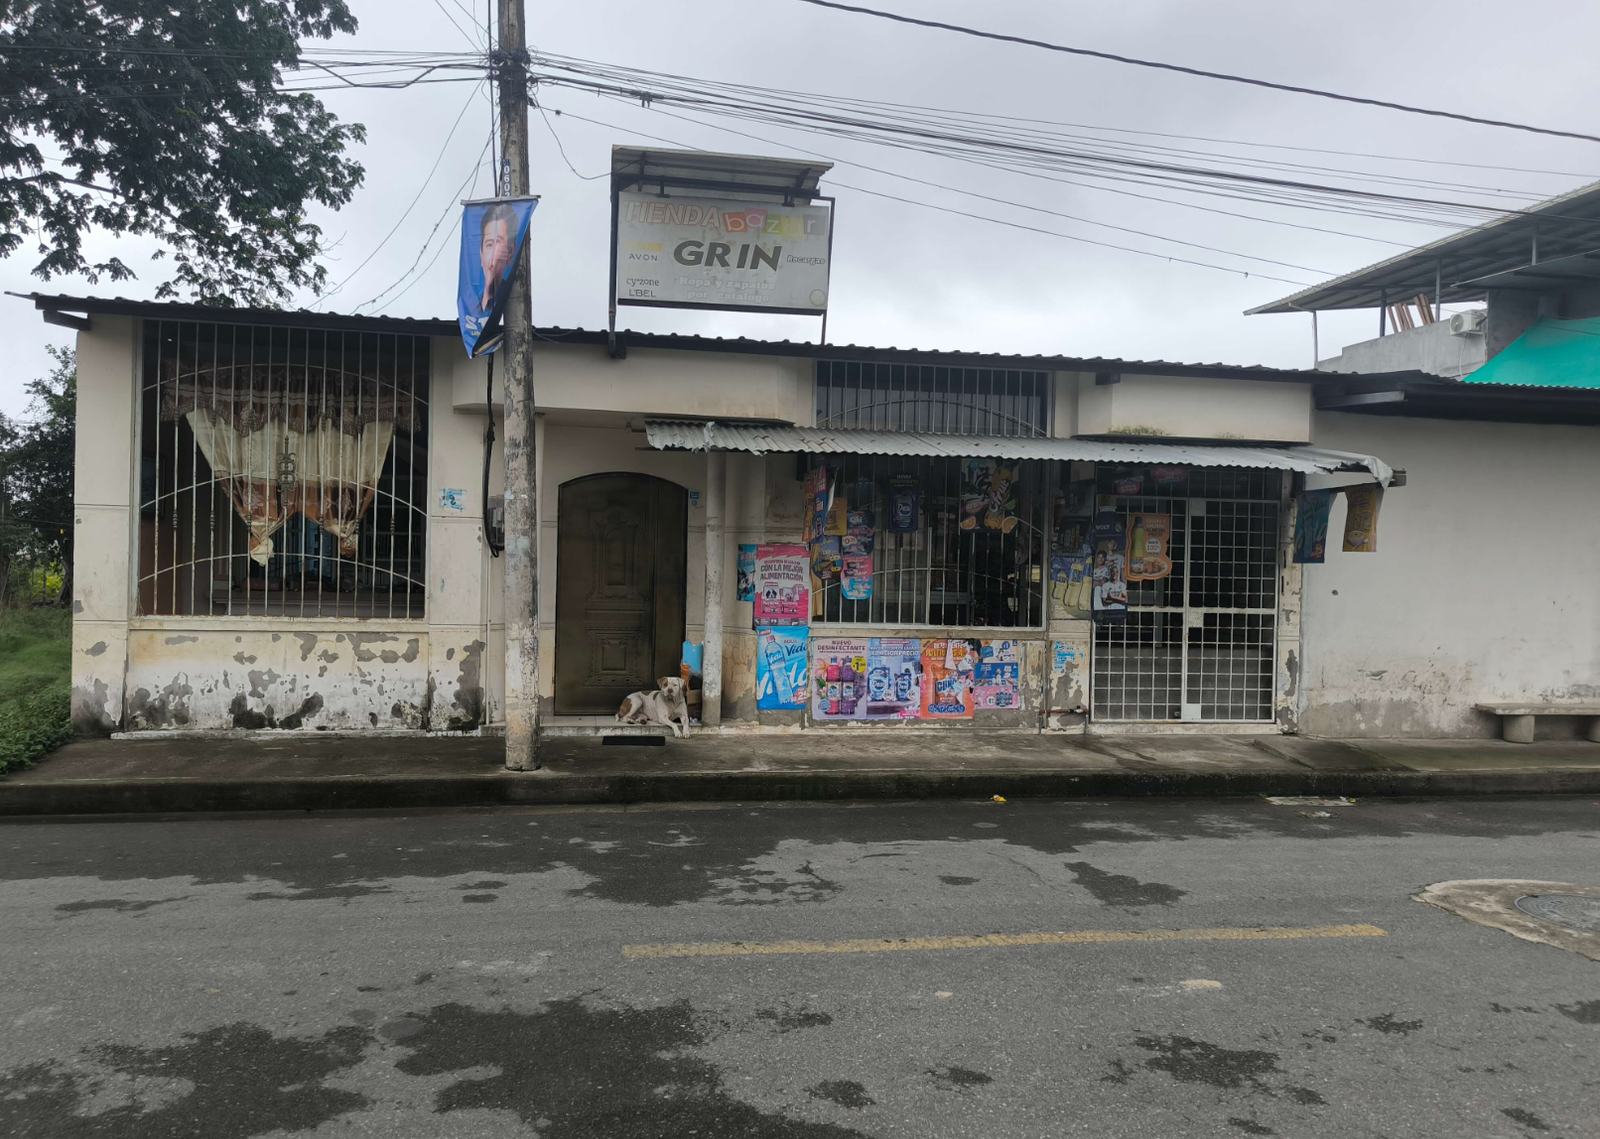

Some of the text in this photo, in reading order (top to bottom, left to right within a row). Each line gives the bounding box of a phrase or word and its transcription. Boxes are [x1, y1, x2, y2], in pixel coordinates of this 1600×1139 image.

[624, 201, 818, 238] TIENDA bazar
[628, 253, 658, 262] AVON
[674, 240, 783, 272] GRIN
[786, 255, 826, 265] Recargas
[678, 276, 775, 291] Ropa y zapatos
[687, 291, 709, 300] por
[760, 564, 773, 572] CON
[783, 565, 803, 574] MEJOR
[760, 572, 804, 582] ALIMENTACIÓN
